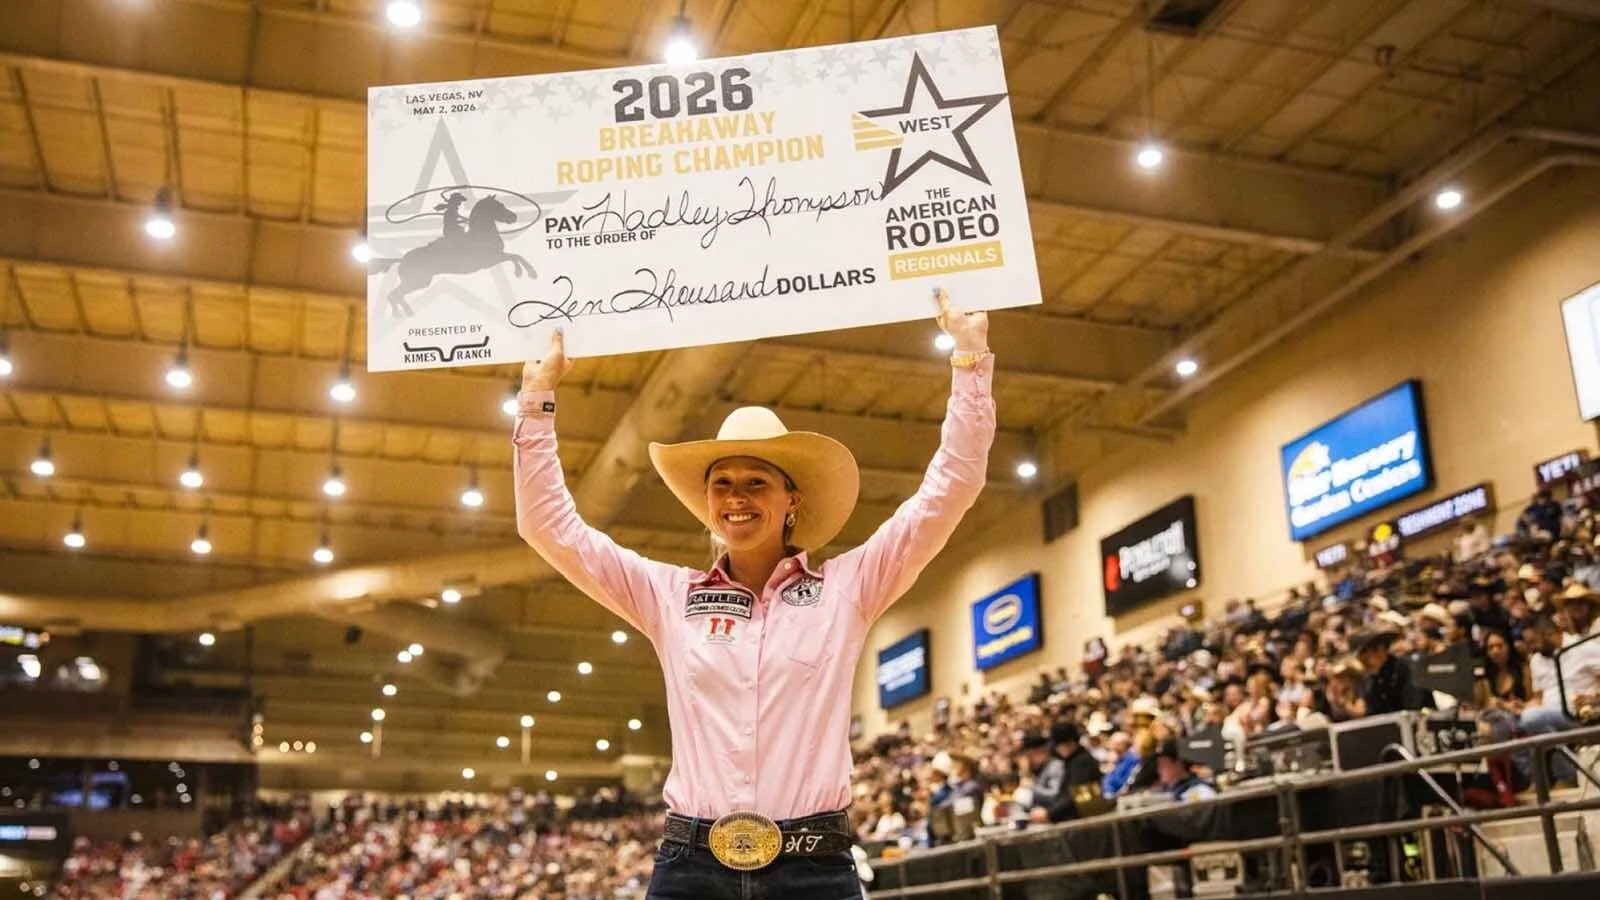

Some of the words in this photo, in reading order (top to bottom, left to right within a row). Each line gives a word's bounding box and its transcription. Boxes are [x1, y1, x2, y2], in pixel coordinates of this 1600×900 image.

[405, 94, 426, 105] LAS
[428, 91, 466, 102] VEGAS,
[468, 90, 484, 99] NV
[612, 67, 754, 123] 2026
[413, 106, 435, 116] MAY
[439, 105, 448, 114] 2,
[451, 103, 476, 113] 2026
[598, 111, 777, 152] BREAKAWAY
[899, 115, 952, 134] WEST
[556, 152, 663, 185] ROPING
[674, 134, 825, 174] CHAMPION
[925, 187, 951, 199] THE
[582, 189, 729, 248] Hadley
[727, 176, 888, 236] Thompson
[886, 194, 997, 223] AMERICAN
[545, 215, 584, 233] PAY
[885, 213, 1000, 250] RODEO
[546, 238, 562, 249] TO
[565, 235, 591, 248] THE
[594, 231, 637, 246] ORDER
[640, 229, 657, 241] OF
[894, 247, 997, 274] REGIONALS
[776, 268, 876, 295] DOLLARS
[508, 275, 613, 328] Ten
[611, 264, 777, 323] Thousand
[408, 325, 467, 337] PRESENTED
[470, 324, 483, 334] BY
[404, 352, 437, 363] KIMES
[457, 348, 491, 360] RANCH
